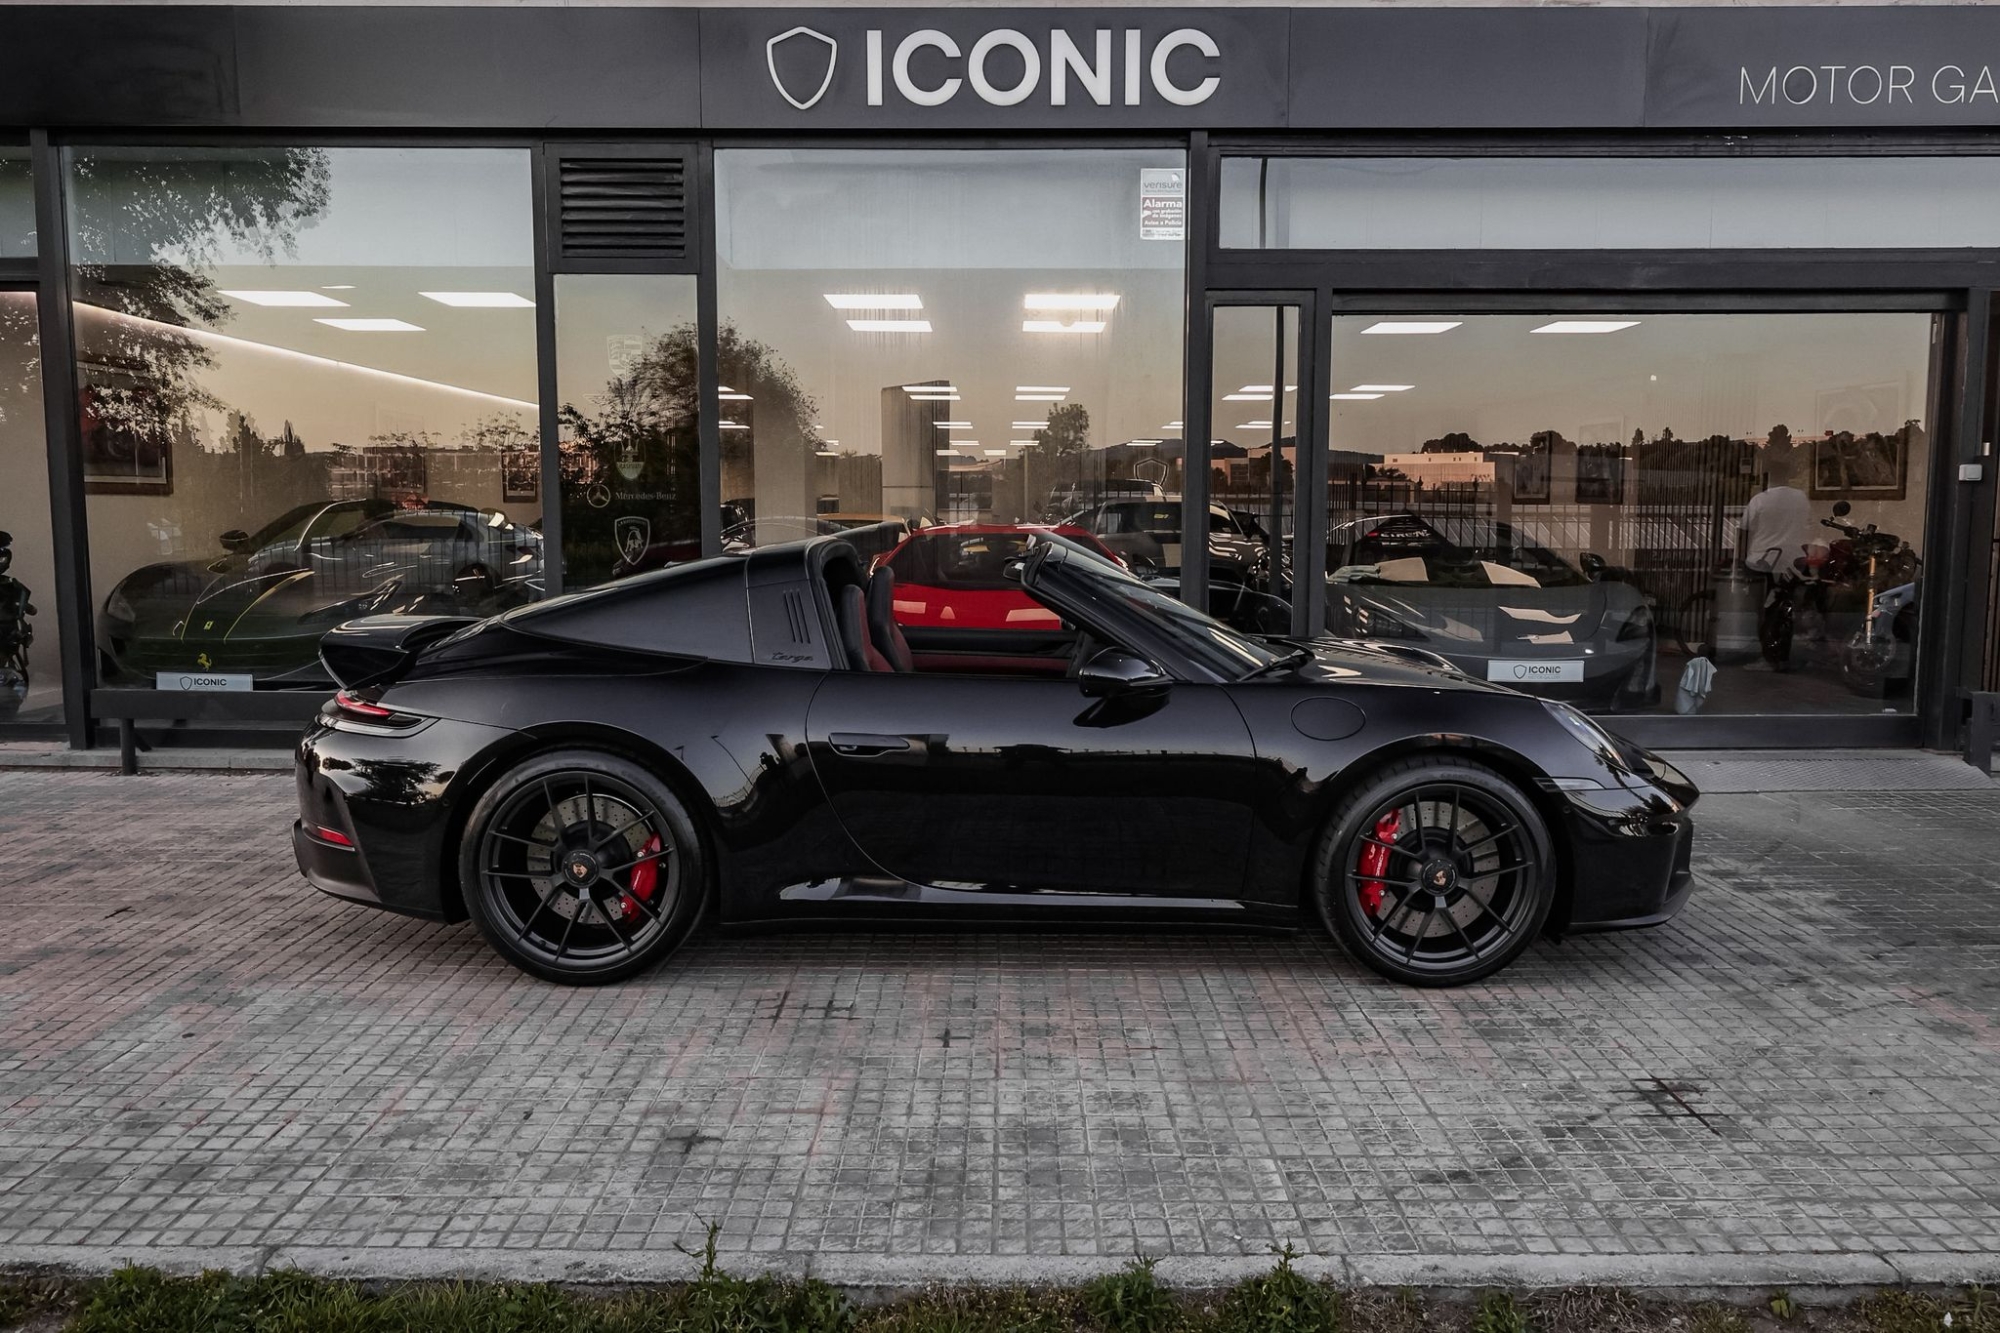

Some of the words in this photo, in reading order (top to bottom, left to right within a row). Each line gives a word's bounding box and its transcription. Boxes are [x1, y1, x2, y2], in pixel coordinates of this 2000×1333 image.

[866, 28, 1221, 107] ICONIC
[1739, 65, 1915, 105] MOTOR
[1931, 65, 2000, 105] GA
[1143, 181, 1183, 189] verisure
[1143, 199, 1182, 208] Alarma
[615, 491, 677, 501] Mercedes-Benz
[1528, 666, 1561, 674] ICONIC
[194, 678, 227, 686] ICONIC
